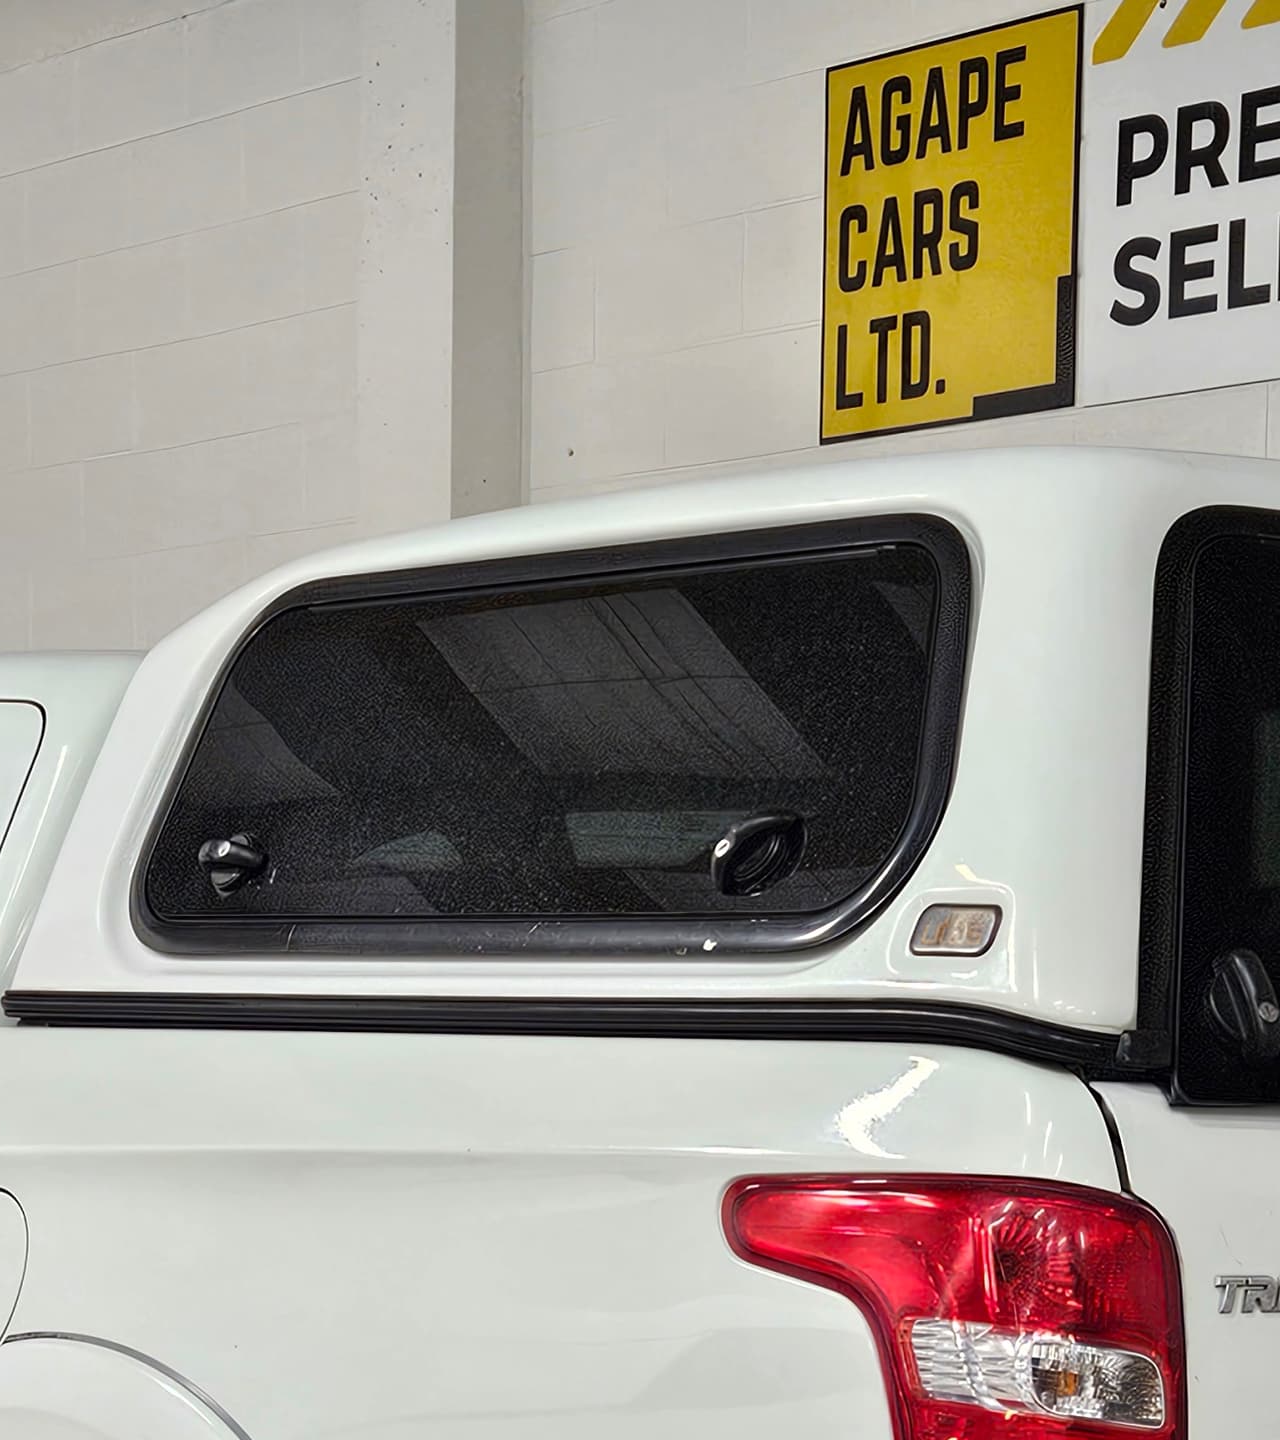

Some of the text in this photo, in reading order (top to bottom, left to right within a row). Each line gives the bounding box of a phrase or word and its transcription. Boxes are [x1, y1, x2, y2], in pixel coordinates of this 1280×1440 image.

[840, 45, 1027, 176] AGAPE
[838, 180, 981, 293] CARS
[835, 309, 946, 411] LTD.
